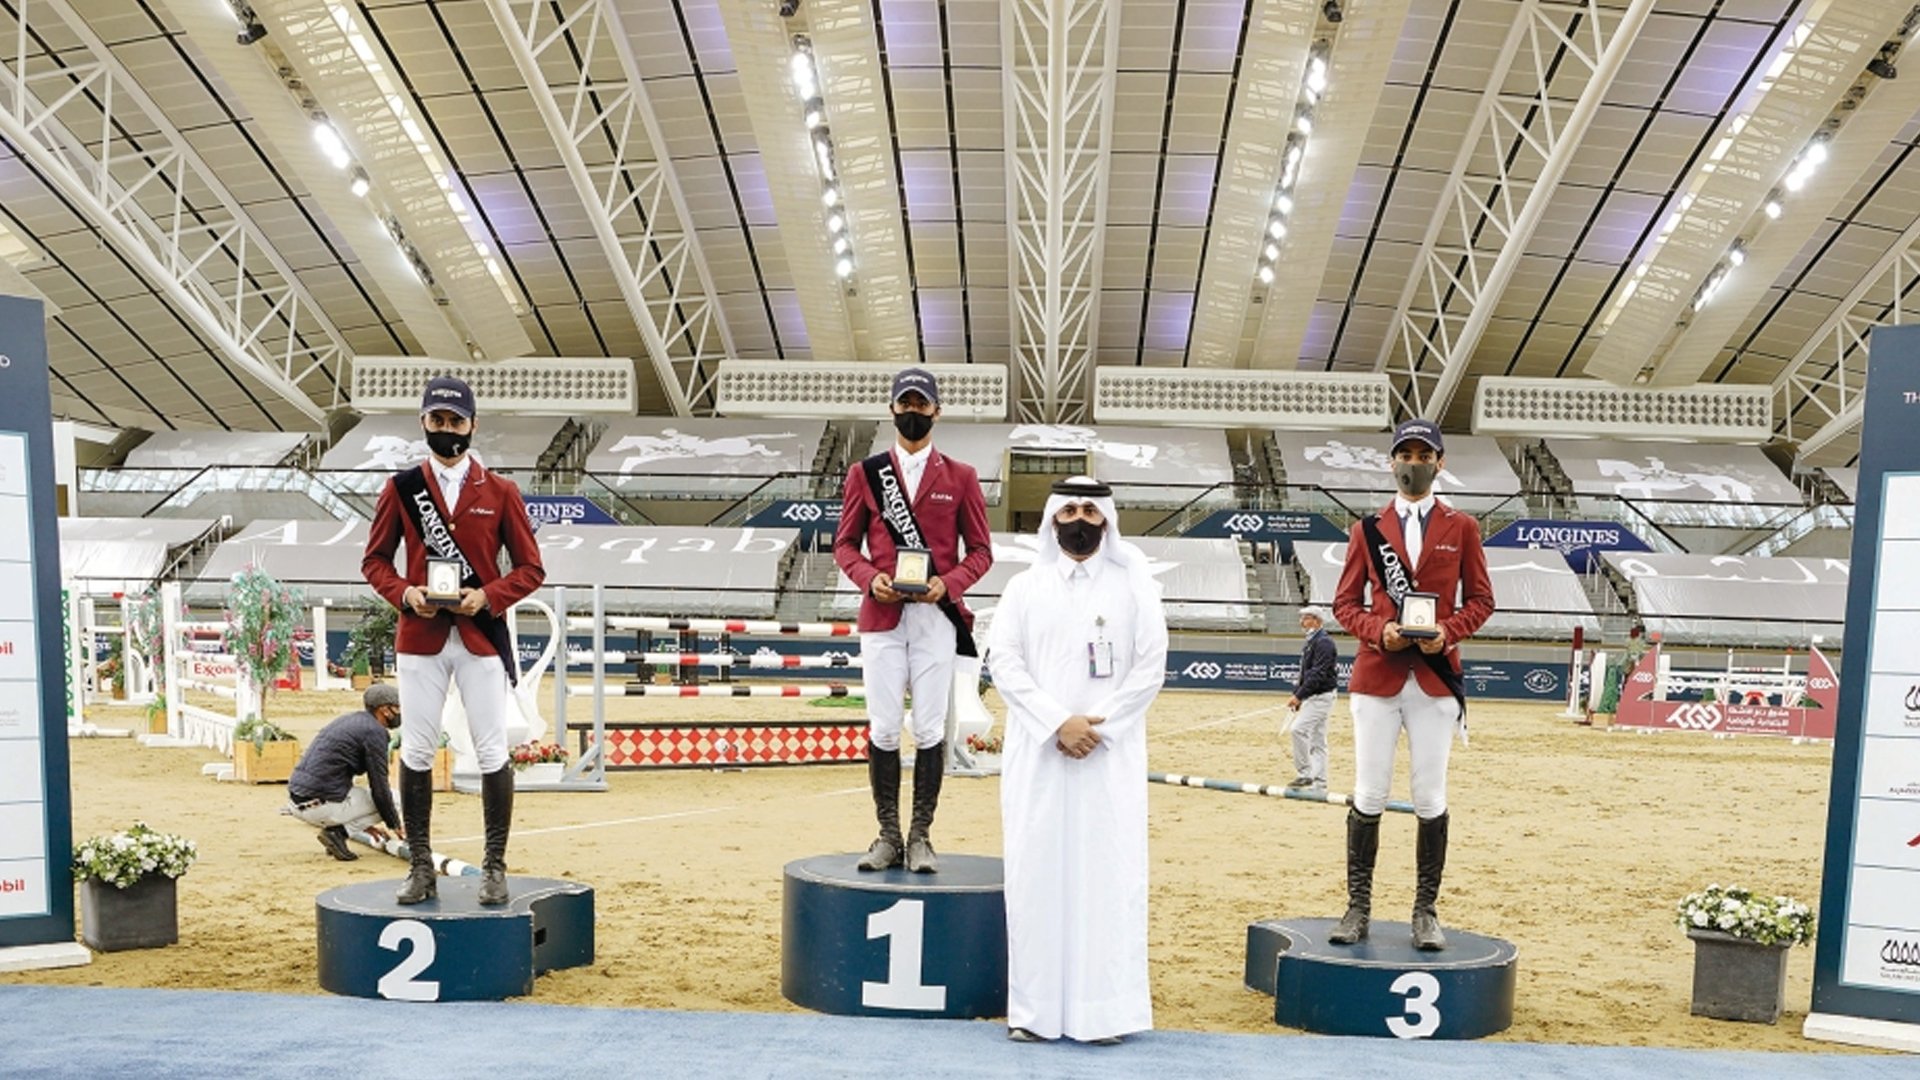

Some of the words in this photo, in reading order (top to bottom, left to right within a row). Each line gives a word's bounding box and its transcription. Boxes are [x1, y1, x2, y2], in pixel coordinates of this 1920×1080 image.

[412, 488, 474, 580] LONGINS
[539, 528, 788, 564] aqab
[1517, 526, 1619, 545] LONGINES
[1379, 543, 1412, 599] LONG
[194, 662, 238, 678] Exxon
[0, 879, 25, 892] bil
[377, 919, 440, 1001] 2
[862, 898, 947, 1011] 1
[1384, 971, 1441, 1039] 3
